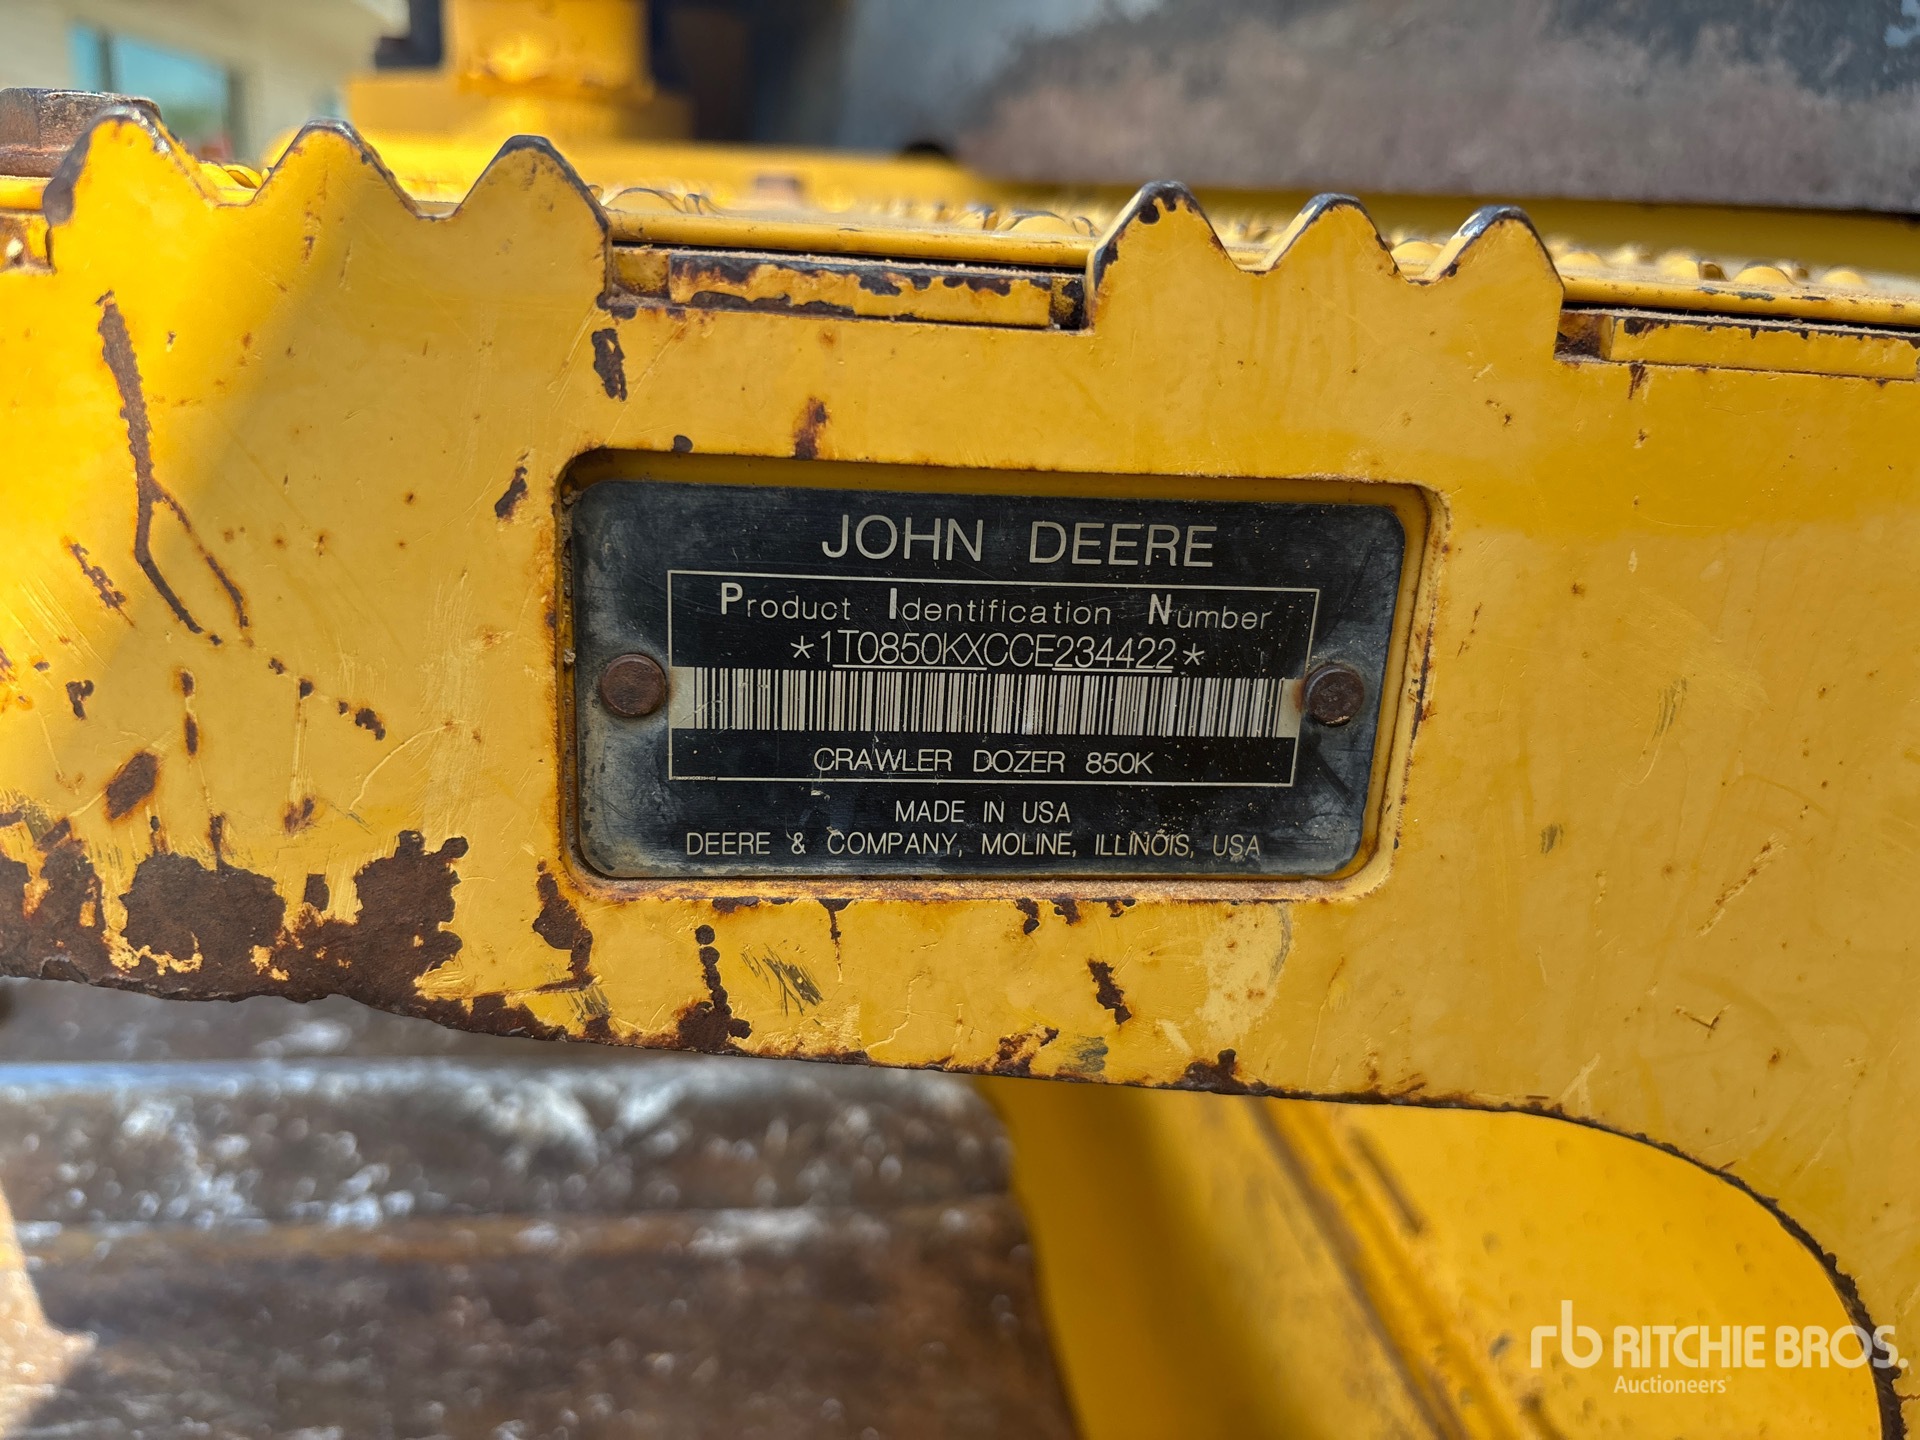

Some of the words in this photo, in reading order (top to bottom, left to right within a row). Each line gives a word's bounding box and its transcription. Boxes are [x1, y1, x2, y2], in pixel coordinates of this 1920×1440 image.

[822, 514, 983, 562] JOHN
[1029, 520, 1218, 567] DEERE
[720, 582, 851, 621] Product
[889, 588, 1111, 625] Identification
[1148, 594, 1272, 630] Number
[813, 748, 952, 772] CRAWLER
[973, 750, 1066, 774] DOZER
[1085, 752, 1154, 775] 850K
[895, 800, 965, 823] MADE
[983, 801, 1005, 823] IN
[1022, 801, 1071, 823] USA
[686, 832, 771, 856] DEERE
[790, 832, 807, 855] &
[827, 832, 964, 858] COMPANY,
[981, 833, 1077, 858] MOLINE,
[1095, 833, 1195, 859] ILLINOIS,
[1212, 834, 1261, 857] USA
